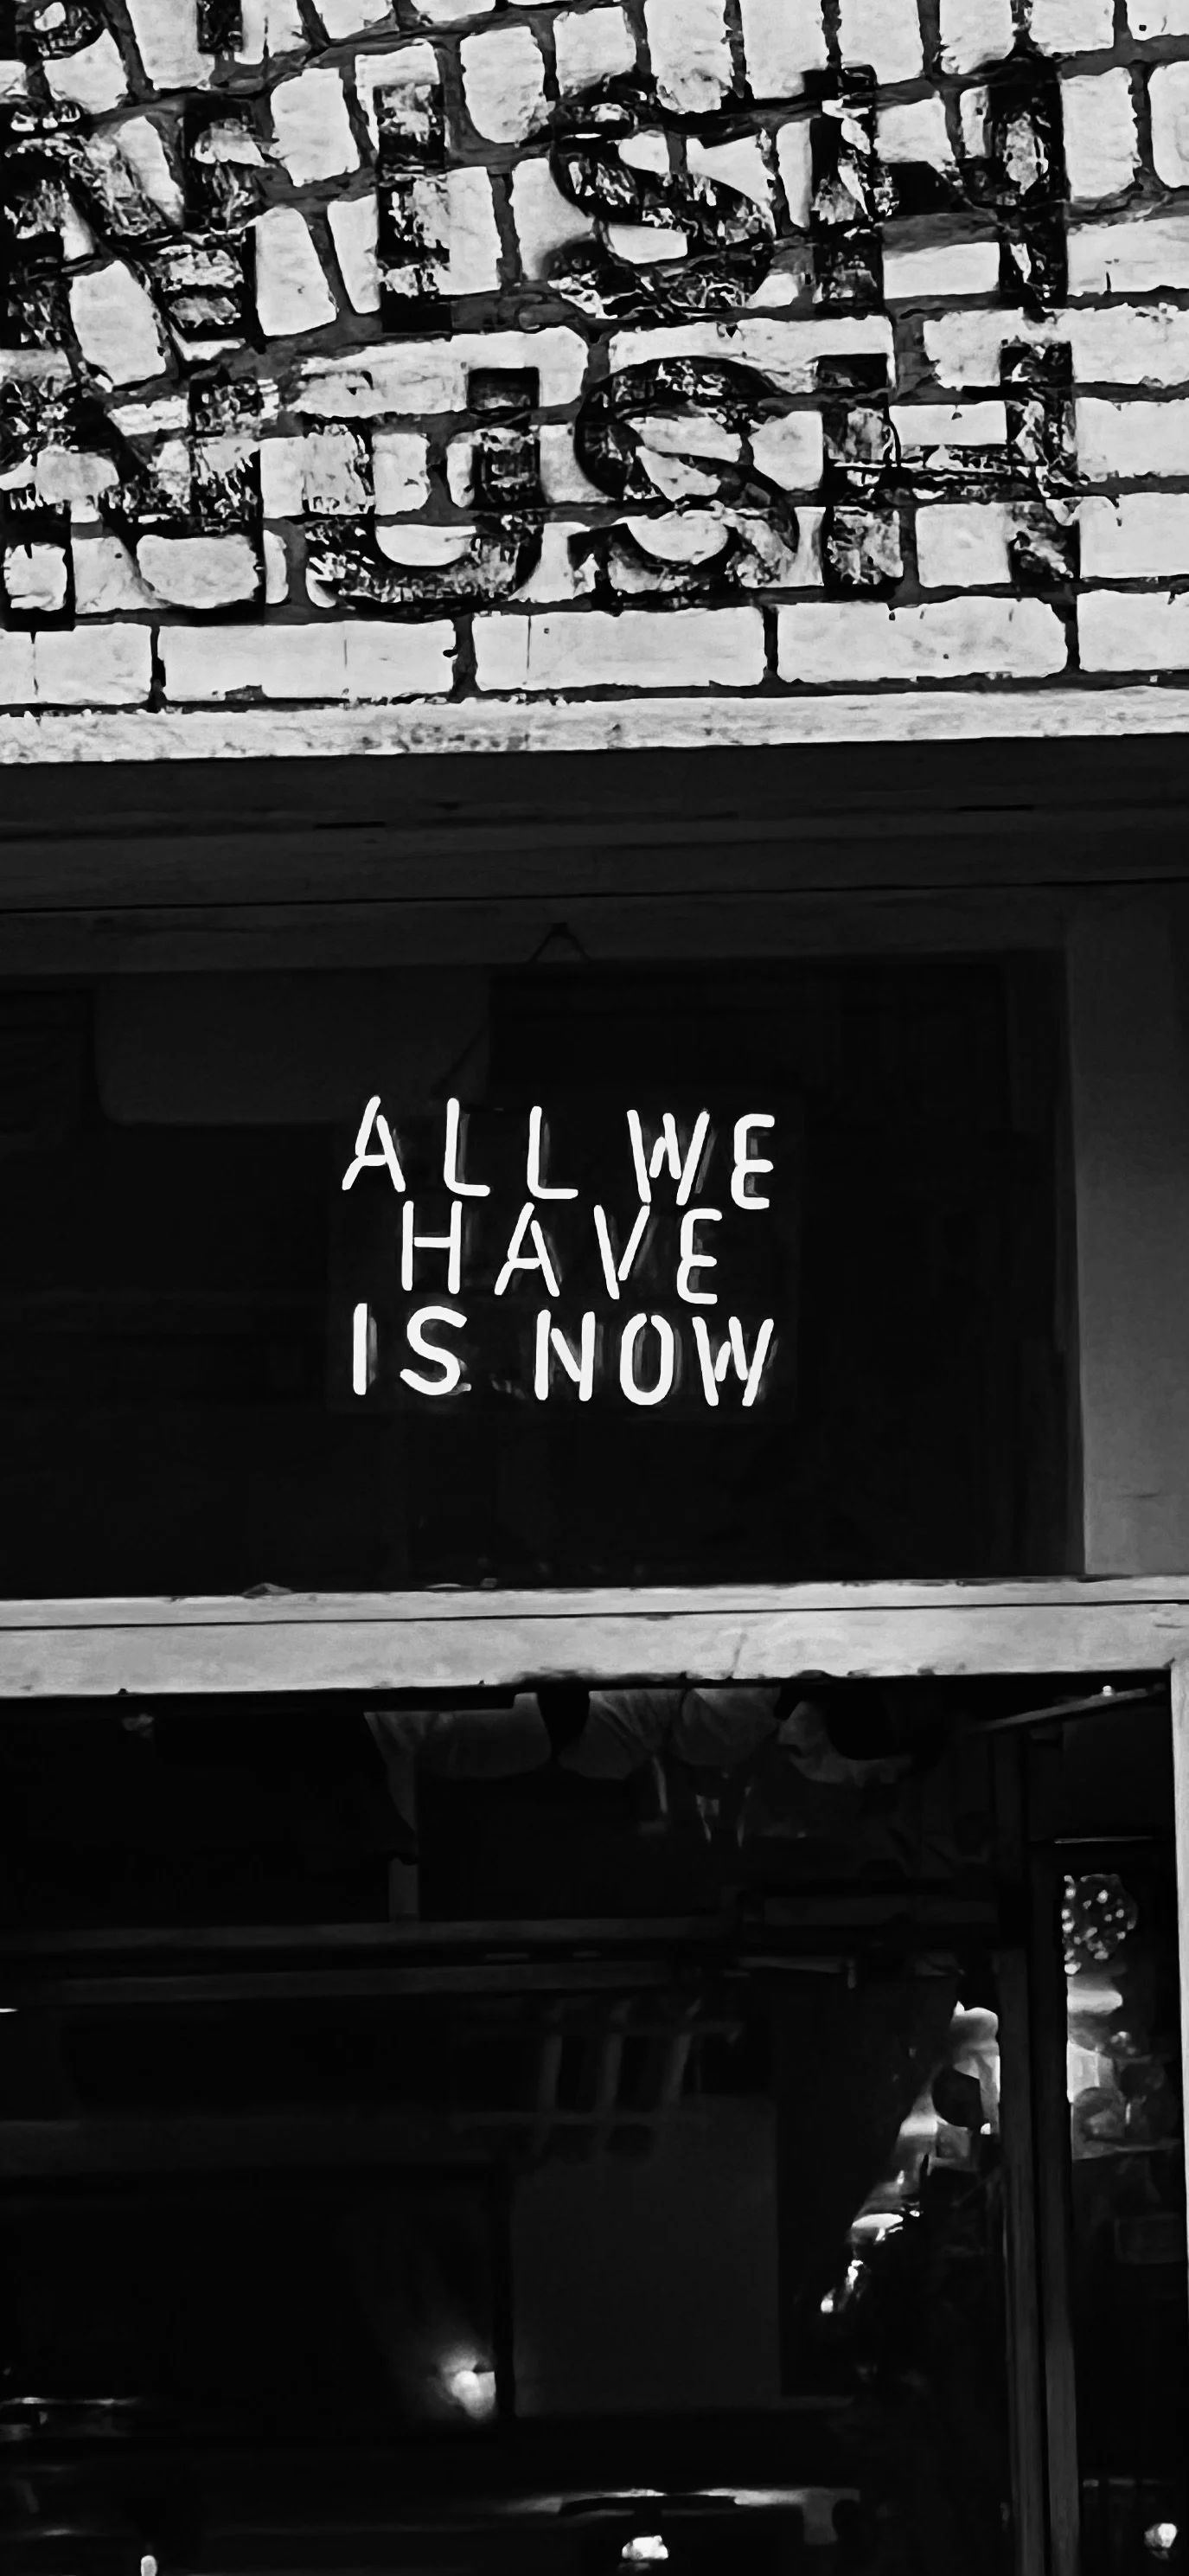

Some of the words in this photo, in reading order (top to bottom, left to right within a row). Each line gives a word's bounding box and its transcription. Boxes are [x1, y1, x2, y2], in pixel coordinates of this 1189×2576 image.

[342, 1095, 579, 1199] ALL
[627, 1109, 775, 1210] WE
[401, 1200, 723, 1304] HAVE
[352, 1303, 467, 1395] IS
[534, 1309, 774, 1406] NOW
